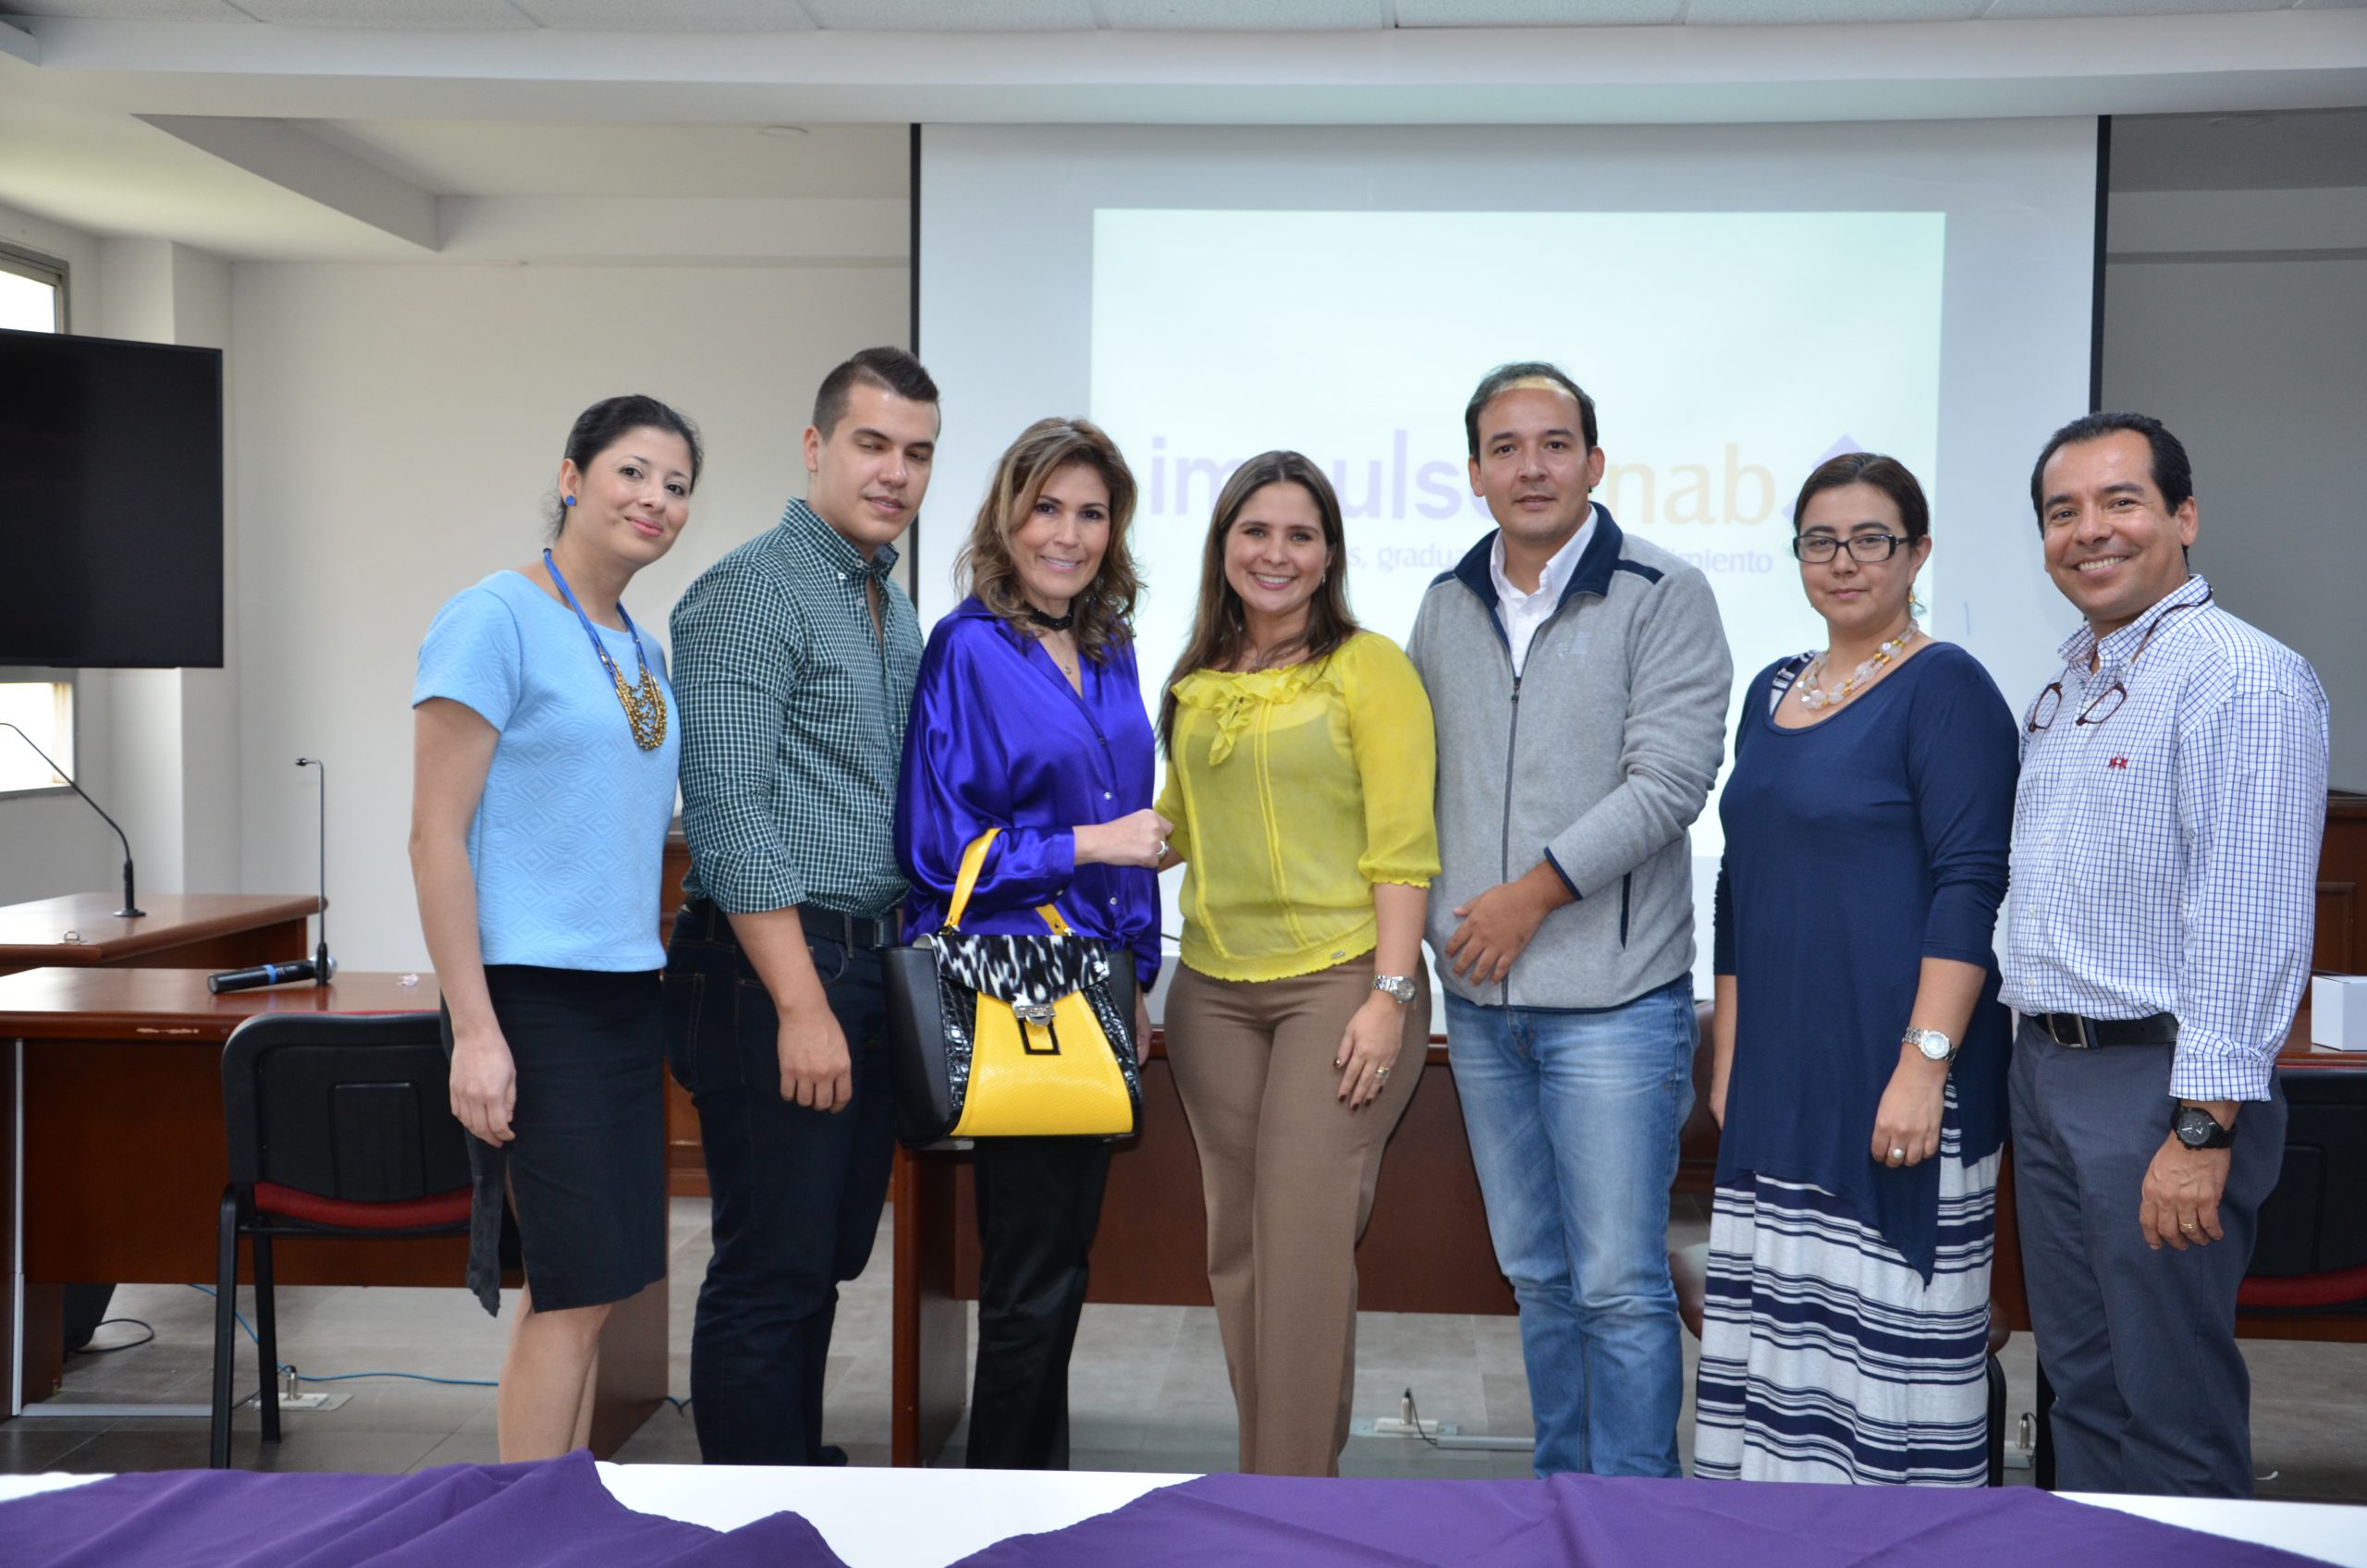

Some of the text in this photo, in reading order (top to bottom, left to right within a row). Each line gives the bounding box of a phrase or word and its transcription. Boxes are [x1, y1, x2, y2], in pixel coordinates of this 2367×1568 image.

[1150, 429, 1775, 526] imuls nab
[1377, 543, 1466, 572] gradua
